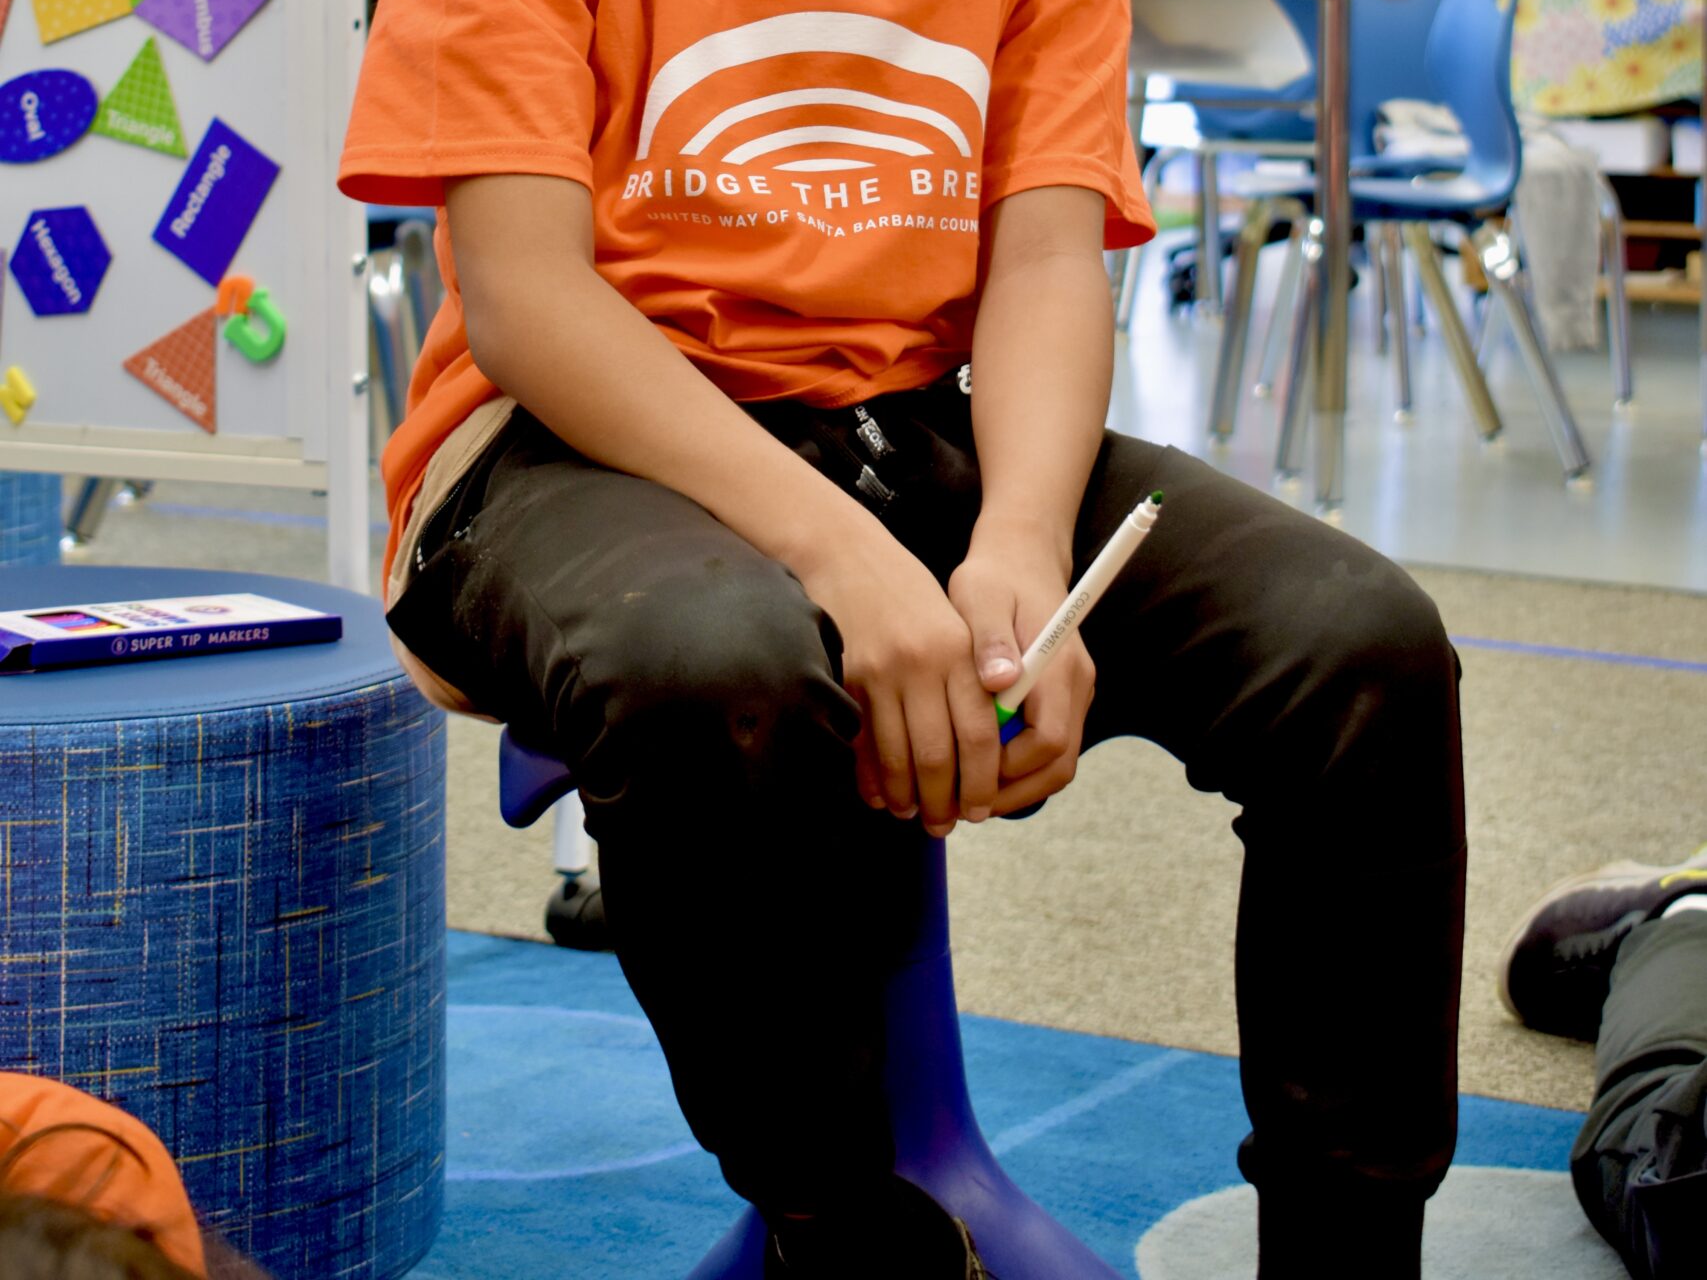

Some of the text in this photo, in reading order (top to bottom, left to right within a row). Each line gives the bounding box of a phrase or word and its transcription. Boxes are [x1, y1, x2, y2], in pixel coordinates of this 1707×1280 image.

[20, 91, 46, 142] Oval
[106, 108, 176, 145] Triangle
[169, 144, 232, 239] Rectangle
[622, 169, 772, 200] BRIDGE
[788, 177, 881, 209] THE
[648, 211, 712, 225] UNITED
[718, 213, 757, 227] WAY
[766, 209, 789, 224] OF
[796, 211, 846, 238] SANTA
[853, 214, 935, 234] BARBARA
[31, 219, 82, 305] Hexagon
[143, 357, 208, 416] Triangle
[130, 635, 173, 652] SUPER
[180, 633, 202, 646] TIP
[208, 627, 270, 644] MARKERS
[1037, 591, 1090, 655] COLOR SWELL
